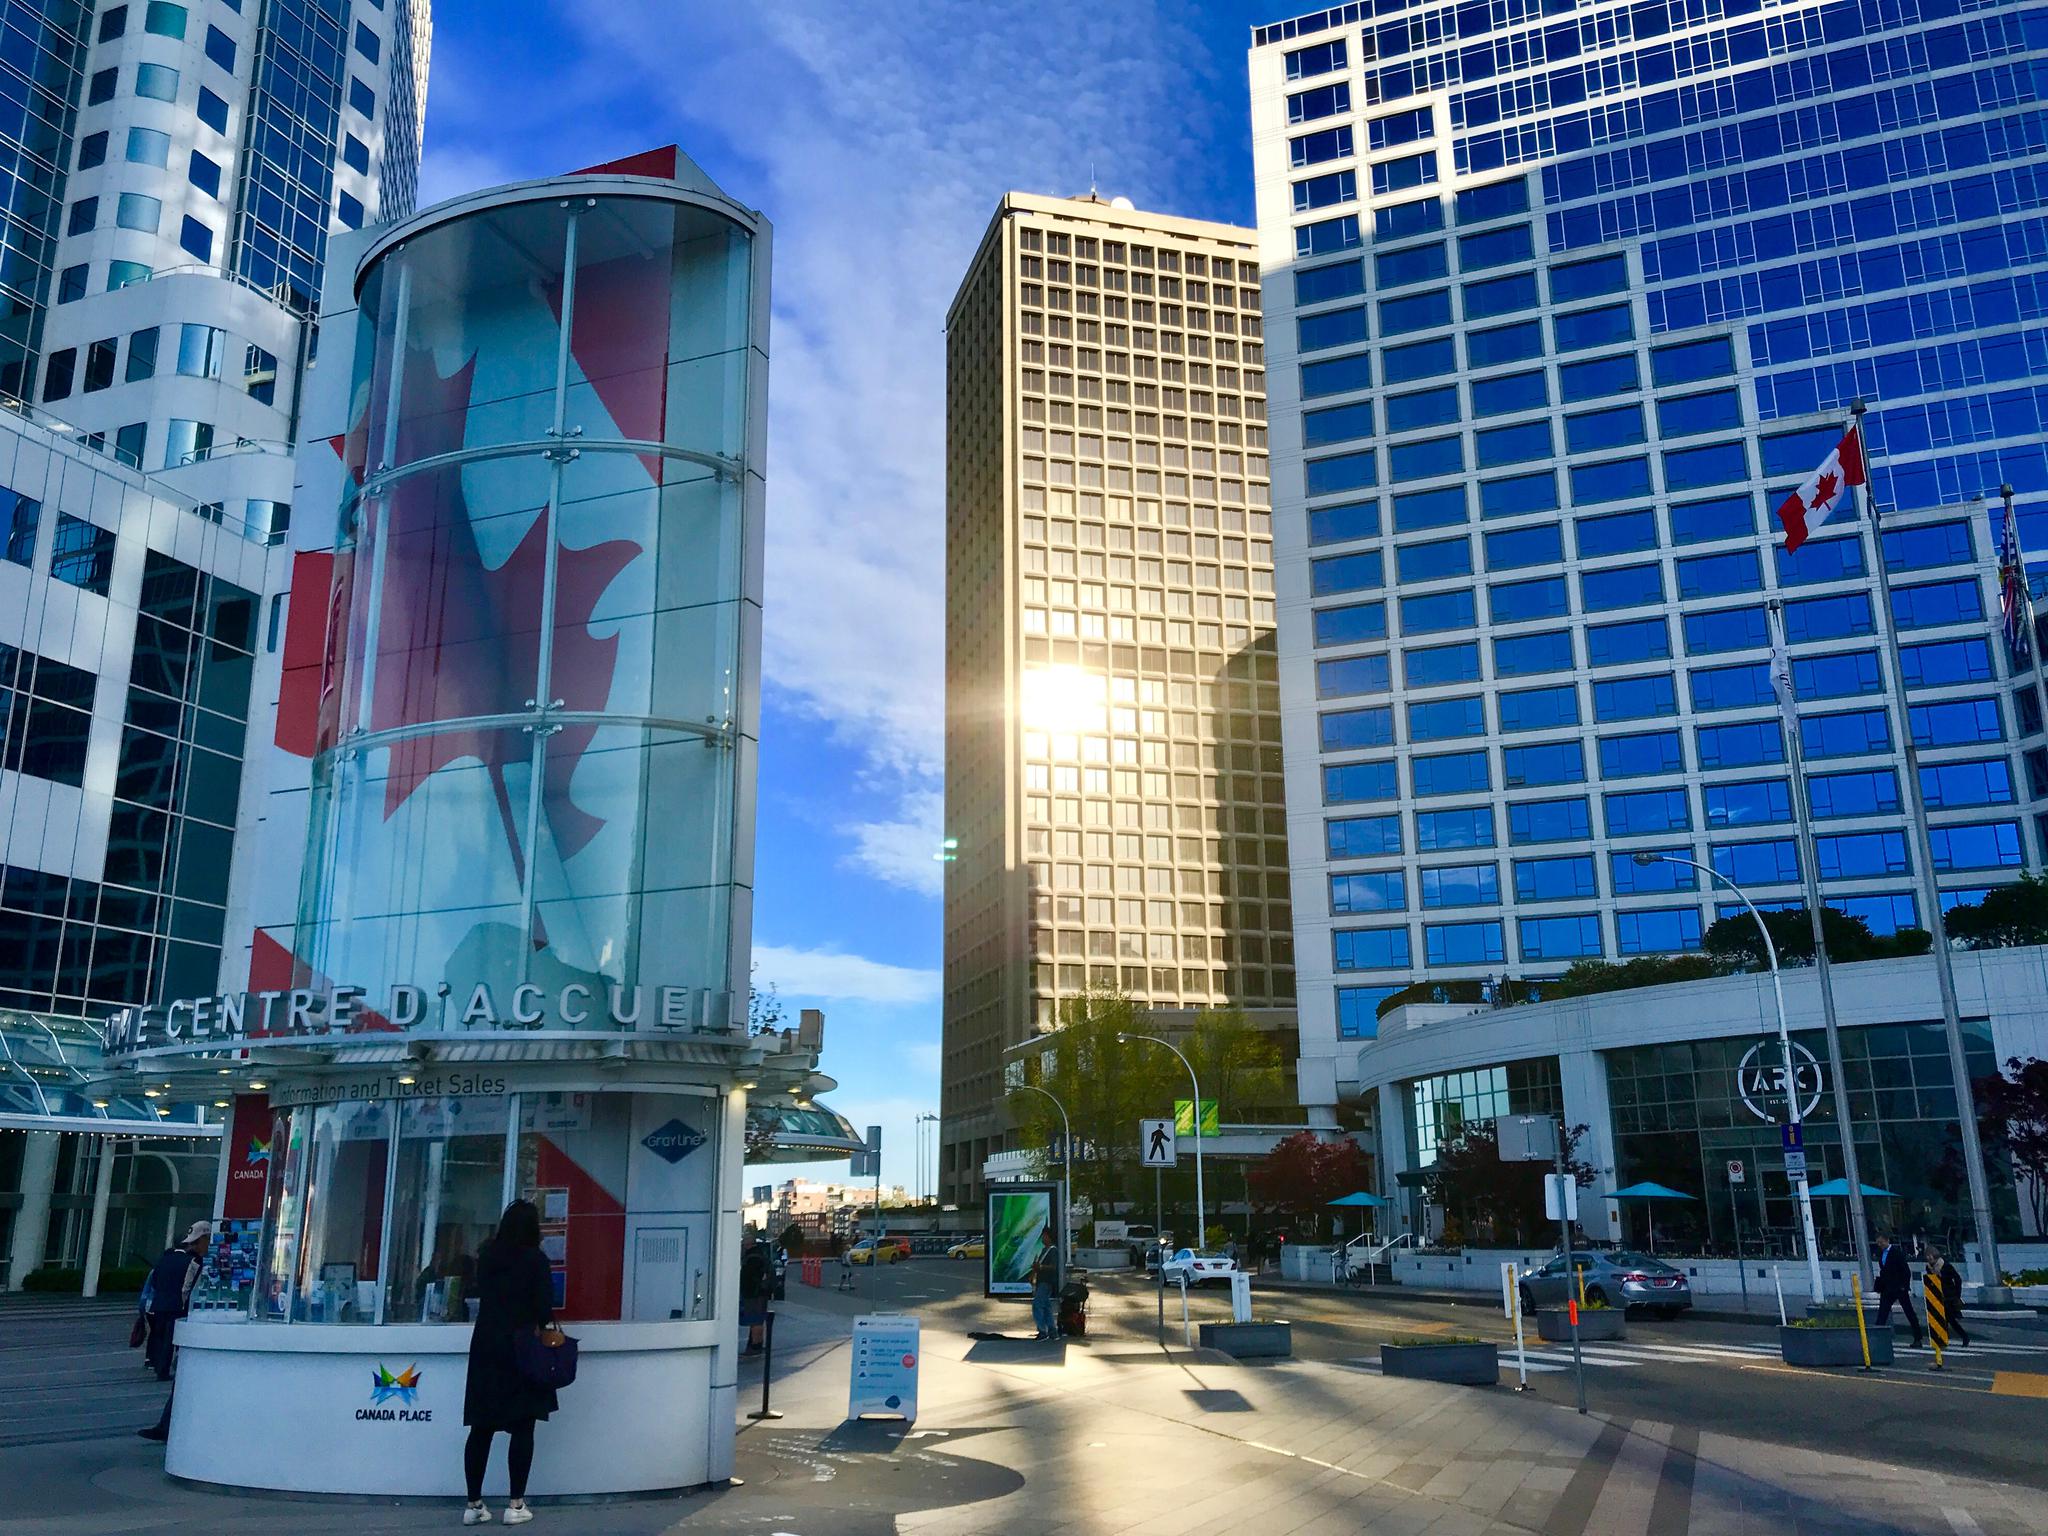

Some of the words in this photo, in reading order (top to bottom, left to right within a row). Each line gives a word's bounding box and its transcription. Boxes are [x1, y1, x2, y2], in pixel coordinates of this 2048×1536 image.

[166, 986, 362, 1038] CENTRE
[351, 1078, 380, 1098] and
[387, 1077, 442, 1096] Ticket
[449, 1074, 505, 1094] Sales
[234, 1170, 264, 1180] CANADA
[355, 1409, 395, 1421] CANADA
[400, 1410, 432, 1421] PLACE
